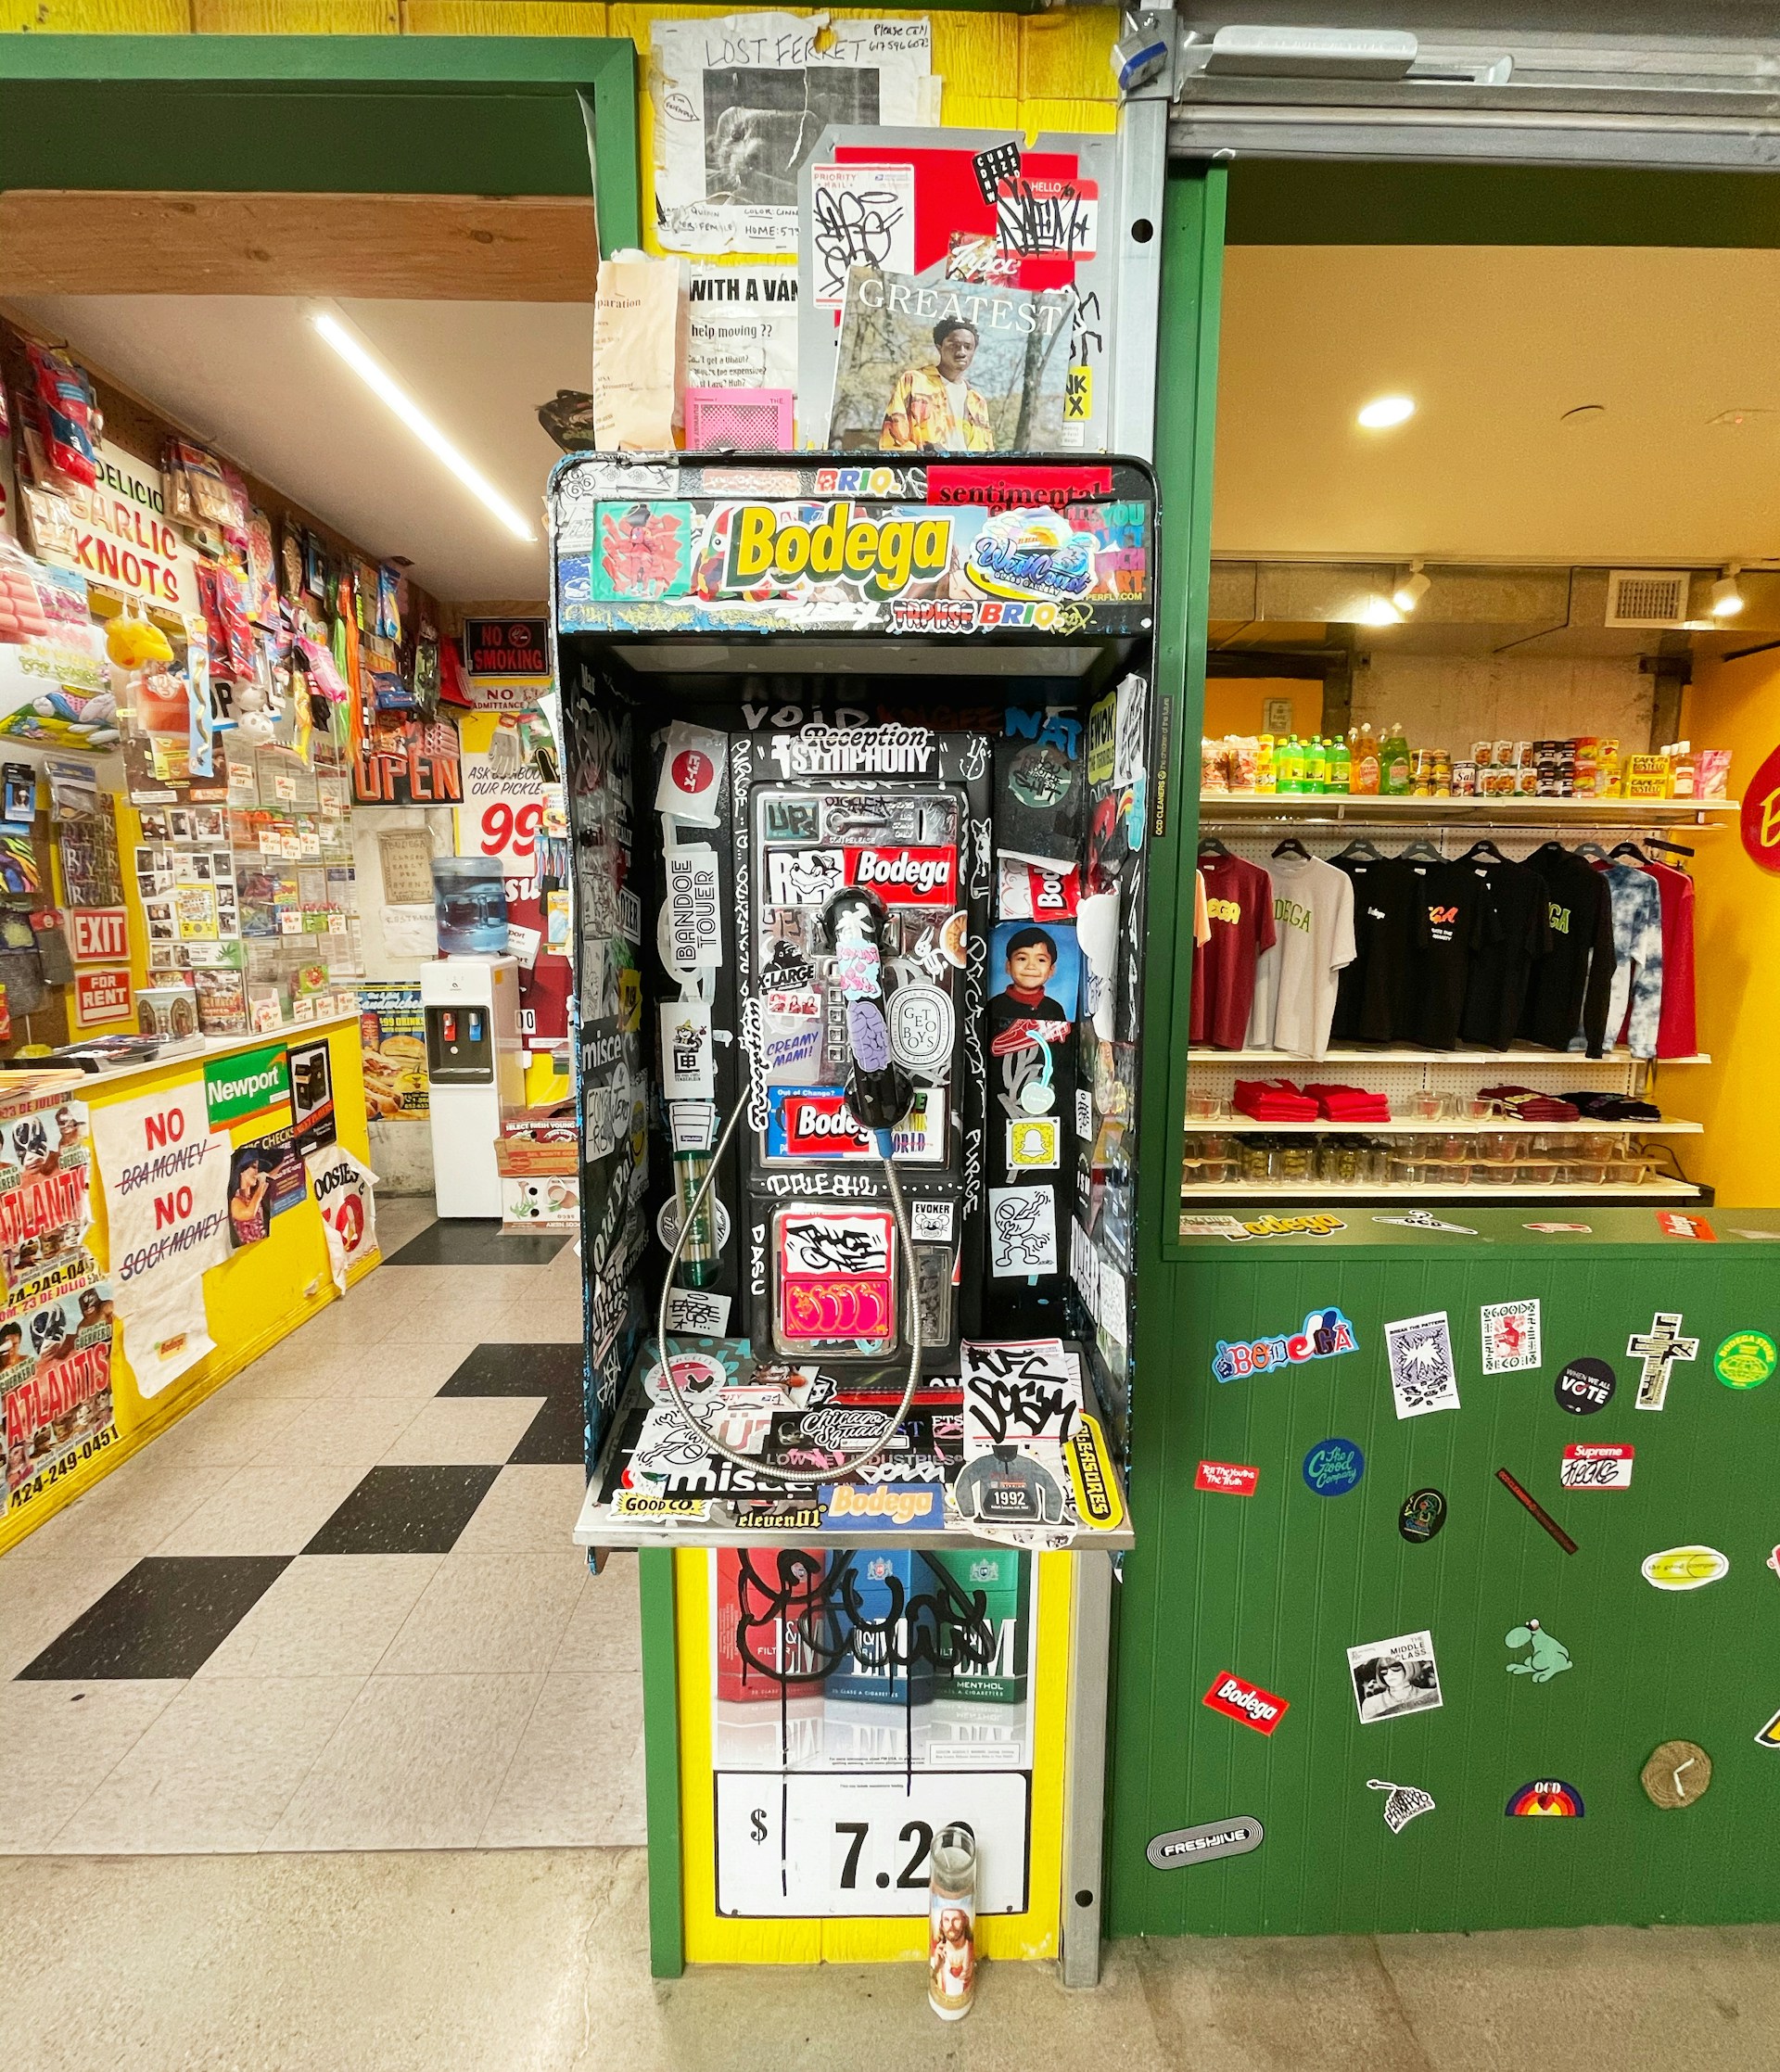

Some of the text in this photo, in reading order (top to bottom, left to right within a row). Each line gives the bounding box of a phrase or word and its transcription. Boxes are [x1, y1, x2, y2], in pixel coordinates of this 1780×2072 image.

[875, 24, 903, 36] Please
[706, 38, 767, 67] LOST
[814, 173, 857, 182] PRIORITY
[1031, 182, 1062, 193] HELLO
[690, 278, 740, 302] WITH
[745, 278, 758, 302] A
[858, 278, 1063, 337] GREATEST
[692, 324, 715, 339] help
[718, 324, 757, 339] moving
[939, 481, 1101, 506] sentimental
[735, 502, 951, 591] Bodega
[73, 527, 181, 604] KNOTS
[1022, 579, 1061, 597] GALLERY
[482, 626, 502, 646] NO
[474, 650, 543, 671] SMOKING
[487, 689, 515, 701] NO
[803, 723, 928, 754] Reception
[791, 744, 933, 773] SYMPHONY
[354, 744, 461, 801] OPEN
[468, 767, 488, 781] ASK
[471, 782, 496, 795] OUR
[1156, 780, 1166, 819] CLEANERS
[1155, 820, 1163, 836] OCD
[857, 850, 950, 892] Bodega
[672, 859, 697, 961] BANDOE
[75, 916, 123, 954] EXIT
[91, 975, 117, 988] FOR
[756, 965, 815, 990] X-LARGE
[83, 987, 127, 1009] RENT
[767, 1031, 819, 1057] CREAMY
[773, 1046, 813, 1067] MAMI!
[208, 1064, 279, 1107] Newport
[777, 1088, 792, 1097] Out
[802, 1088, 835, 1098] Change?
[19, 1102, 32, 1115] DE
[145, 1108, 184, 1151] NO
[506, 1122, 529, 1131] SELECT
[550, 1121, 576, 1129] YOUNG
[262, 1127, 295, 1150] CHECKS
[150, 1138, 209, 1179] MONEY
[154, 1185, 193, 1231] NO
[915, 1203, 950, 1214] EVOKER
[168, 1208, 225, 1256] MONEY
[22, 1278, 87, 1313] 23 DE JULIO
[1421, 1318, 1446, 1328] PATTERN
[74, 1327, 112, 1351] GUERRERO
[1718, 1334, 1755, 1357] BODEGA
[1561, 1375, 1609, 1405] VOTE
[1566, 1367, 1611, 1391] WHEN WE ALL
[6, 1341, 109, 1448] ATLANTIS
[804, 1409, 883, 1436] Chicago
[1325, 1445, 1345, 1462] The
[1574, 1445, 1623, 1458] Supreme
[1202, 1464, 1215, 1475] Tell
[1308, 1450, 1355, 1479] Good
[1206, 1473, 1243, 1486] The Truth
[1316, 1468, 1357, 1489] Company
[626, 1497, 696, 1512] GOOD CO.
[831, 1485, 934, 1521] Bodega
[993, 1490, 1026, 1506] 1992
[1662, 1562, 1685, 1572] good
[1686, 1561, 1723, 1571] company
[1391, 1640, 1426, 1656] MIDDLE
[1410, 1634, 1423, 1643] THE
[1394, 1647, 1428, 1661] CLASS
[957, 1681, 1004, 1691] MENTHOL
[1217, 1679, 1278, 1721] Bodega
[1534, 1781, 1561, 1794] OCD
[750, 1808, 768, 1846] $
